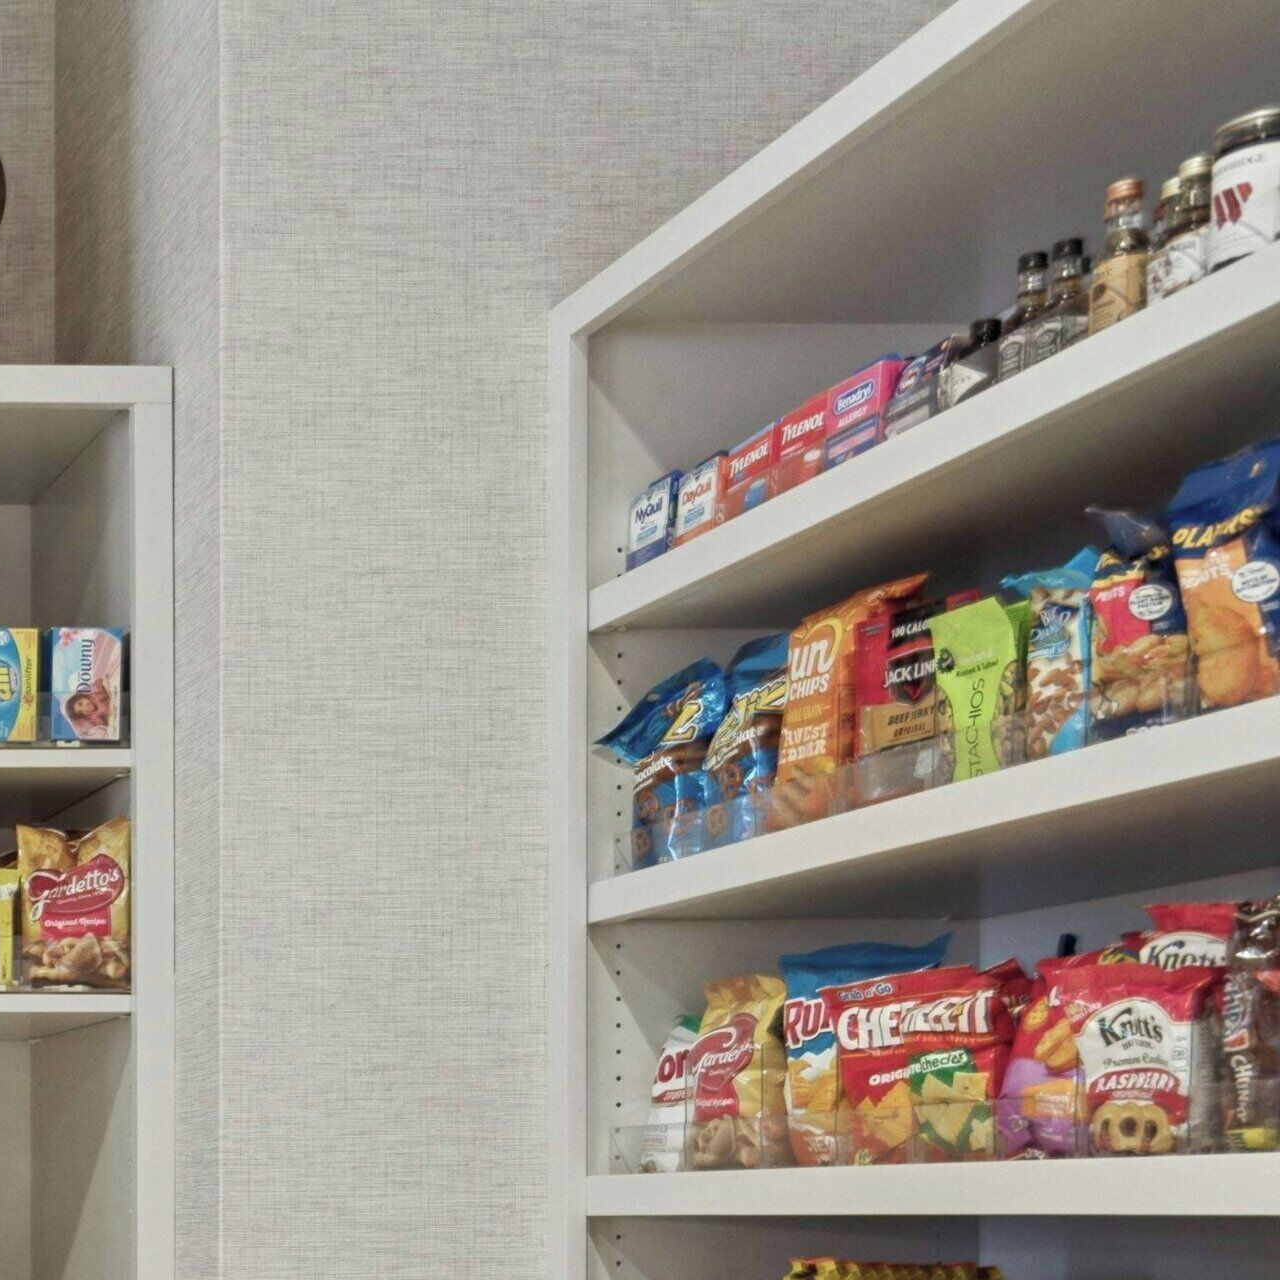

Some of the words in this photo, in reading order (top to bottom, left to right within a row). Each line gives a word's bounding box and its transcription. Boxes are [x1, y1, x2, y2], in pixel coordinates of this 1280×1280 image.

[781, 411, 826, 445] TYLENOL
[729, 444, 769, 479] TYLENOL
[75, 638, 96, 694] Downy
[883, 666, 912, 688] JACK
[1095, 1070, 1175, 1092] RASPBERRY
